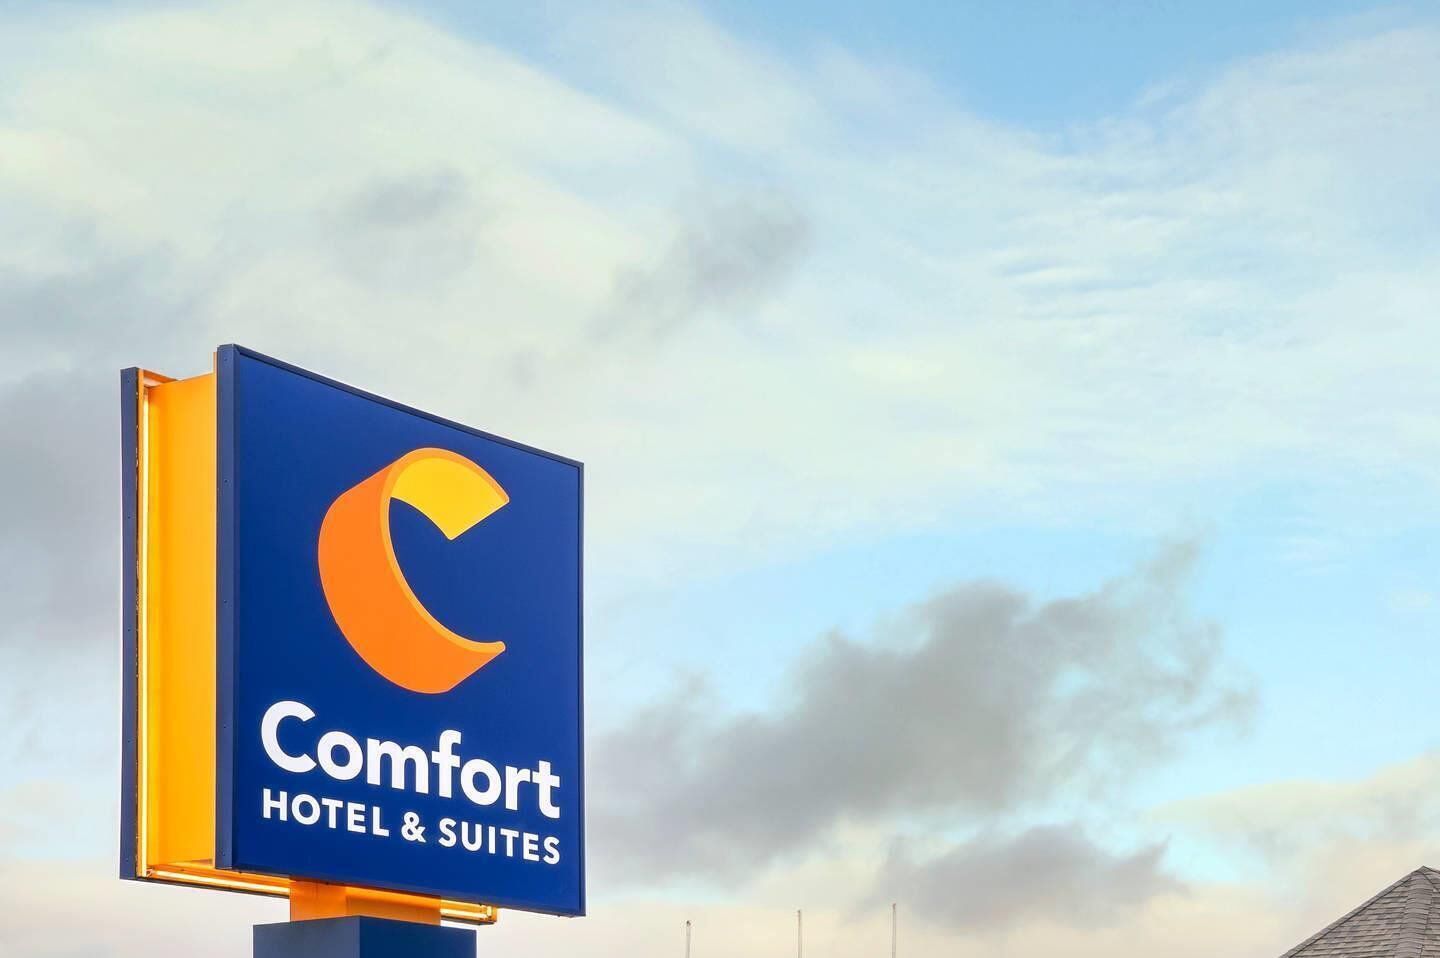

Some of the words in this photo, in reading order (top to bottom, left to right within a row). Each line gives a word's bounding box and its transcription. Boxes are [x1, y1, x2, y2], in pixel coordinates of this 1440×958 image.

[260, 700, 561, 819] Comfort
[262, 789, 389, 838] HOTEL
[401, 811, 427, 844] &
[438, 816, 561, 865] SUITES
